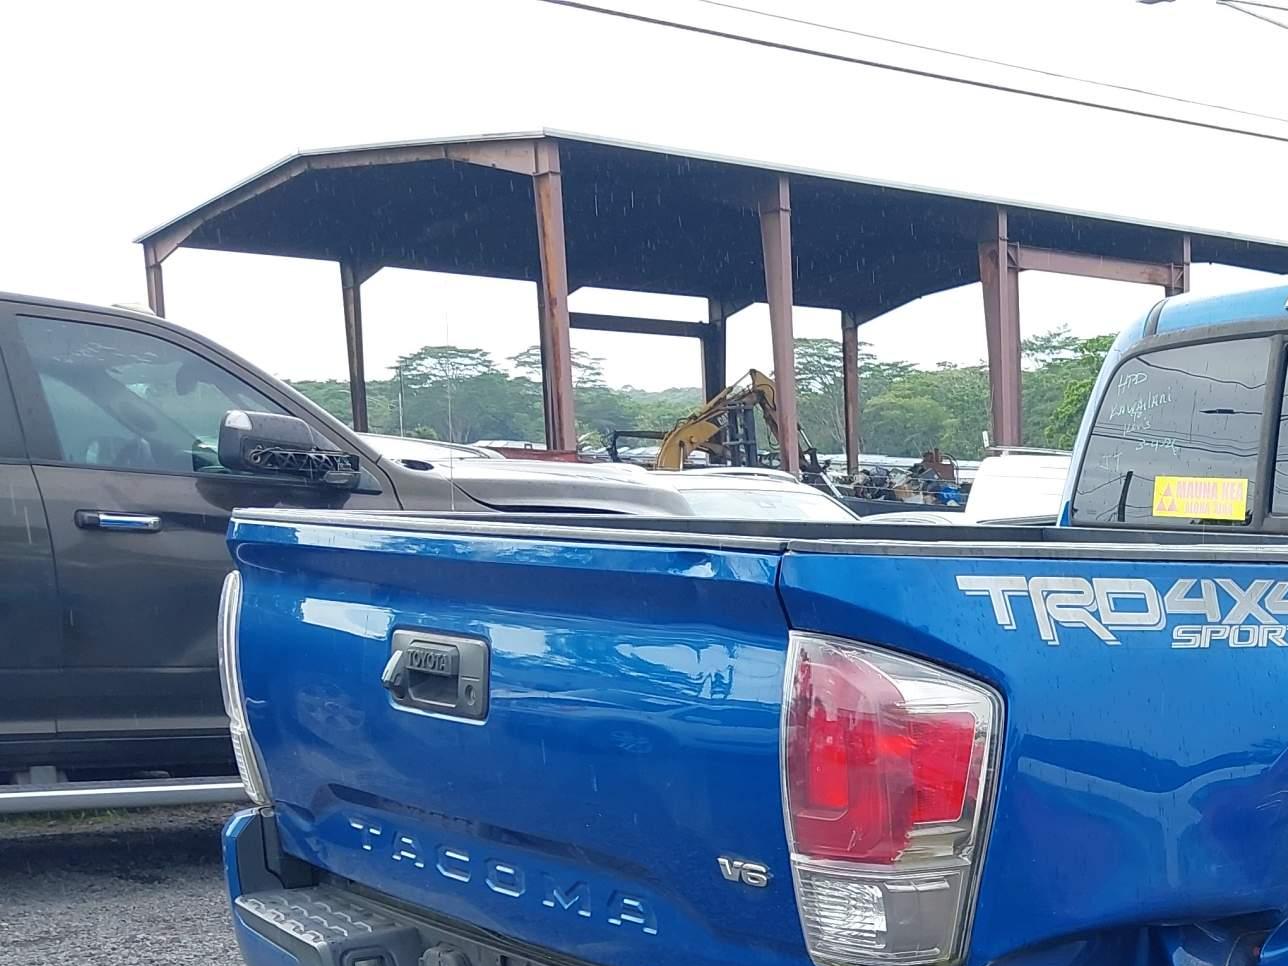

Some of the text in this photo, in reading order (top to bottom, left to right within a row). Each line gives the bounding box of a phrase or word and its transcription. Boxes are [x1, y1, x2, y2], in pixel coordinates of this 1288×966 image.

[954, 575, 1167, 646] TRD
[406, 650, 448, 671] TOYOTA
[348, 815, 658, 936] TACOMA
[717, 856, 770, 888] V6
